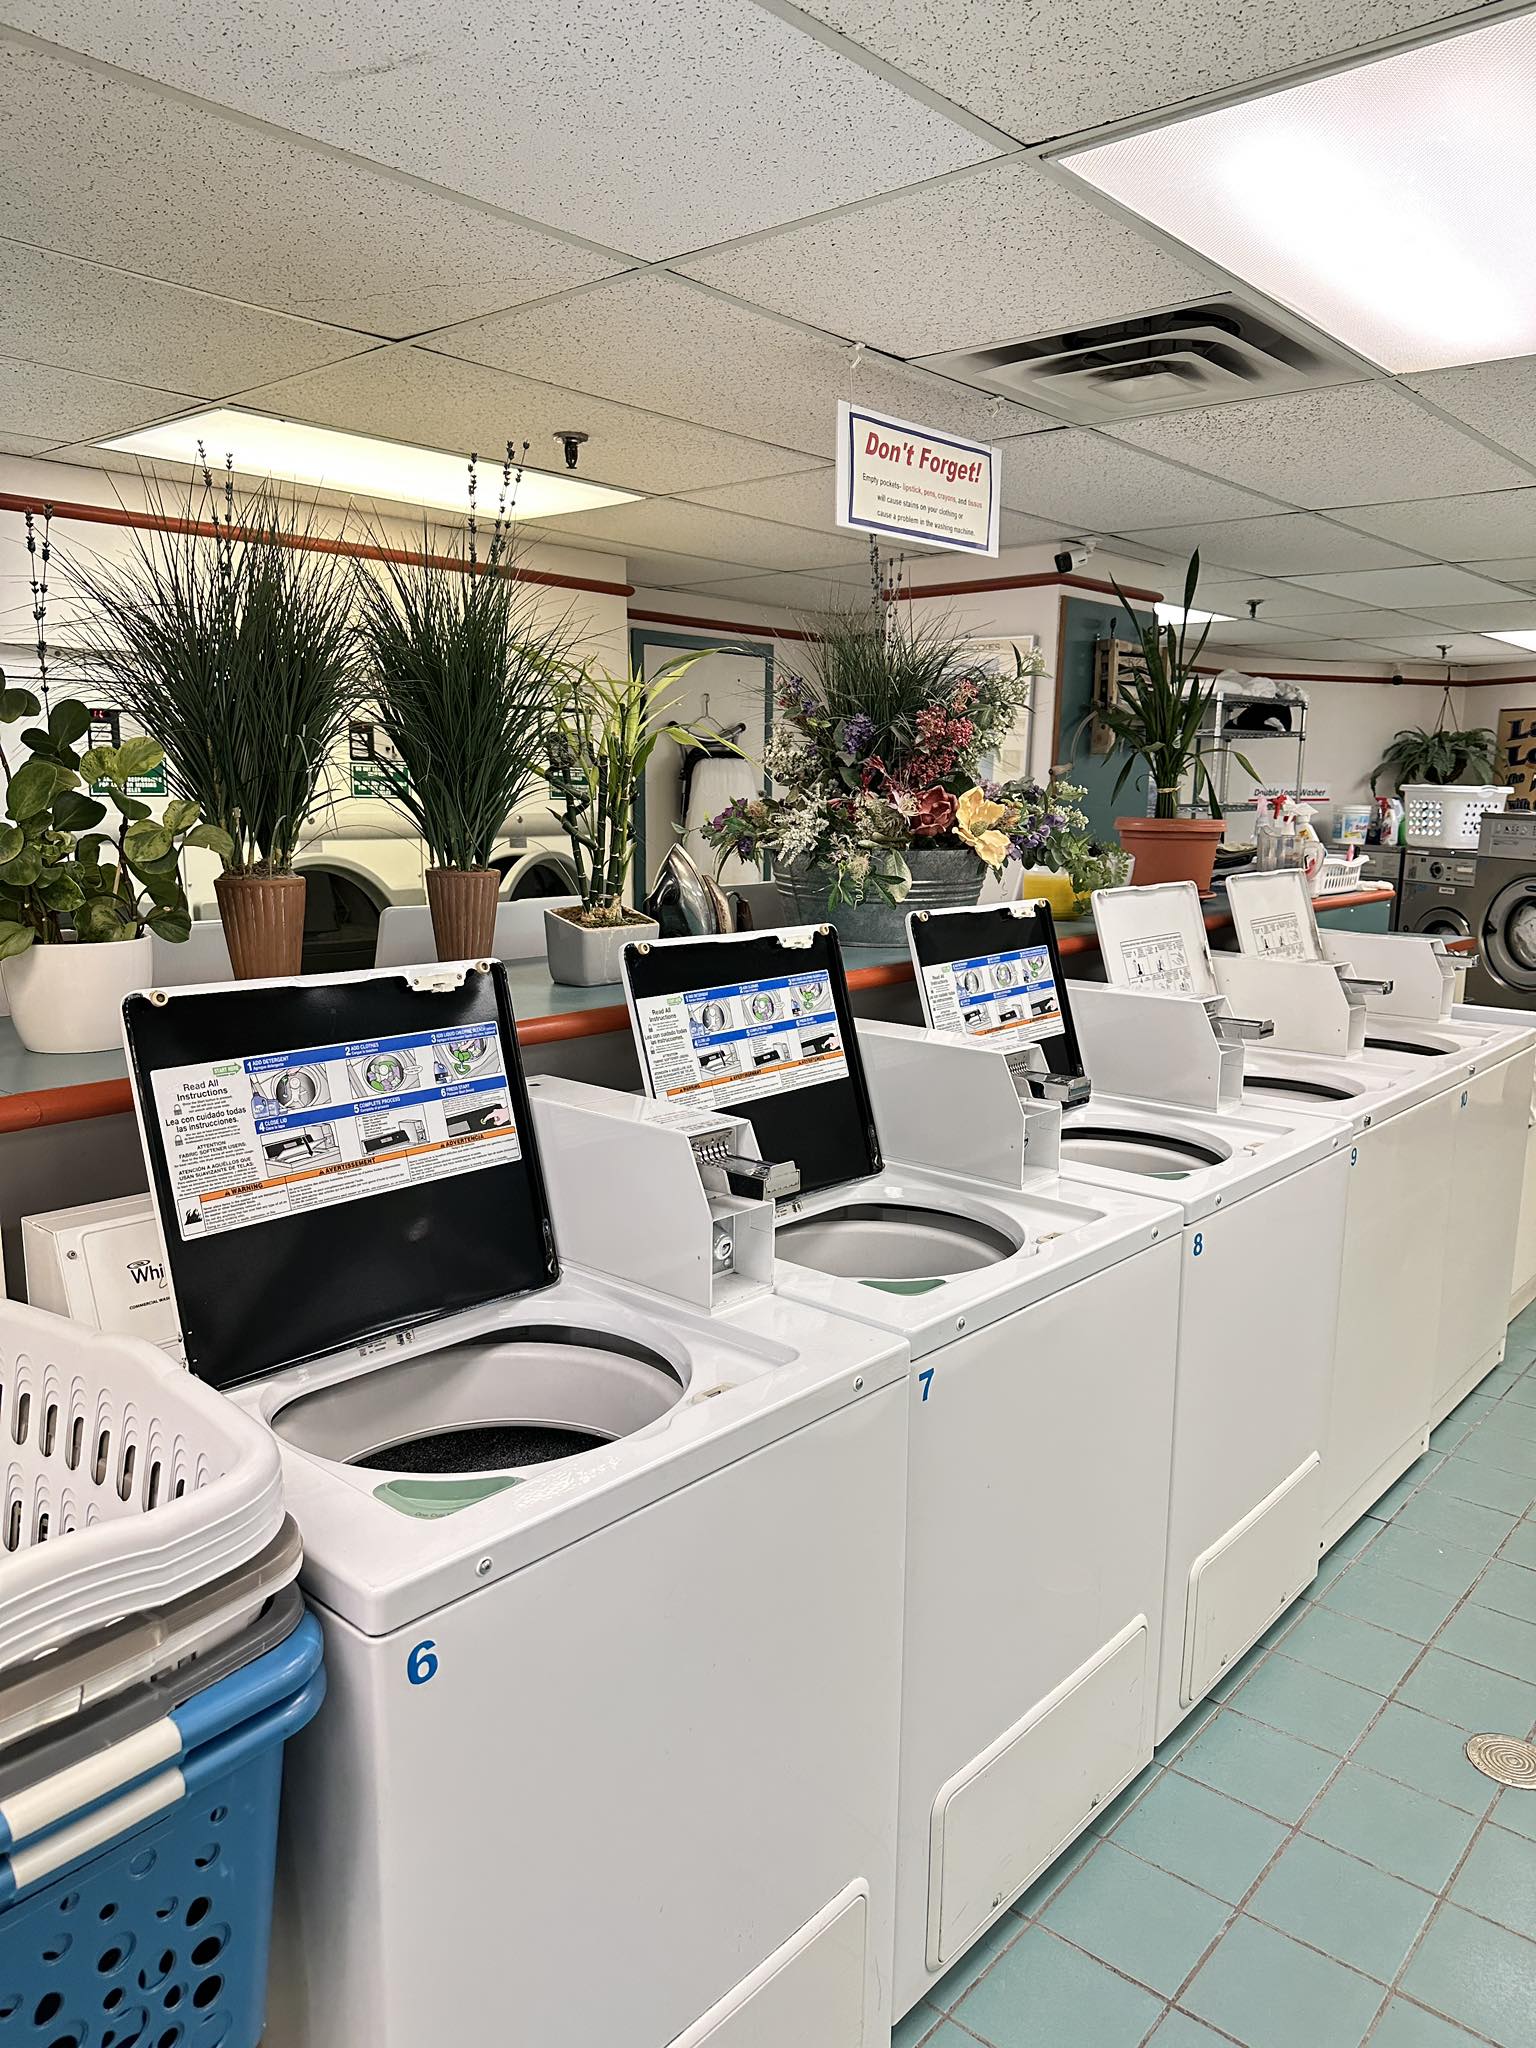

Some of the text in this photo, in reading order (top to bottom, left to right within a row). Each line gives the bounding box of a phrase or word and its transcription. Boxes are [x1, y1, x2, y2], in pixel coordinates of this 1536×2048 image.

[865, 432, 982, 483] Don't Forget!
[862, 472, 879, 486] Empty
[958, 498, 967, 506] and
[877, 494, 885, 502] will
[887, 497, 902, 506] cause
[903, 501, 919, 509] stains
[927, 506, 938, 514] your
[939, 508, 957, 520] clothing
[877, 510, 891, 519] cause
[897, 515, 918, 524] problem
[934, 523, 953, 534] washing
[954, 526, 976, 537] machine.
[1254, 788, 1279, 797] Double
[1300, 788, 1326, 797] Washer
[431, 1034, 436, 1043] 3
[345, 1047, 351, 1056] 2
[247, 1061, 252, 1071] 1
[263, 1056, 289, 1064] DETERGENT
[183, 1079, 219, 1092] Read All
[441, 1088, 447, 1097] 6
[177, 1087, 229, 1102] Instructions
[353, 1104, 359, 1113] 5
[165, 1106, 247, 1127] Lea con cuidado todas
[176, 1116, 239, 1133] las instrucciones.
[259, 1122, 265, 1131] 4
[264, 1118, 279, 1126] CLOSE
[197, 1140, 226, 1150] ATTENTION
[445, 1134, 485, 1147] ADVERTENCIA
[179, 1151, 199, 1159] FABRIC
[199, 1145, 228, 1155] SOFTENER
[1350, 1147, 1357, 1167] 9
[196, 1168, 228, 1177] SUAVIZANTE
[325, 1157, 376, 1174] AVERTISSEMENT
[231, 1183, 263, 1194] WARNING
[1193, 1232, 1204, 1257] 8
[129, 1299, 159, 1311] COMMERCIAL
[918, 1368, 935, 1402] 7
[407, 1640, 439, 1685] 6
